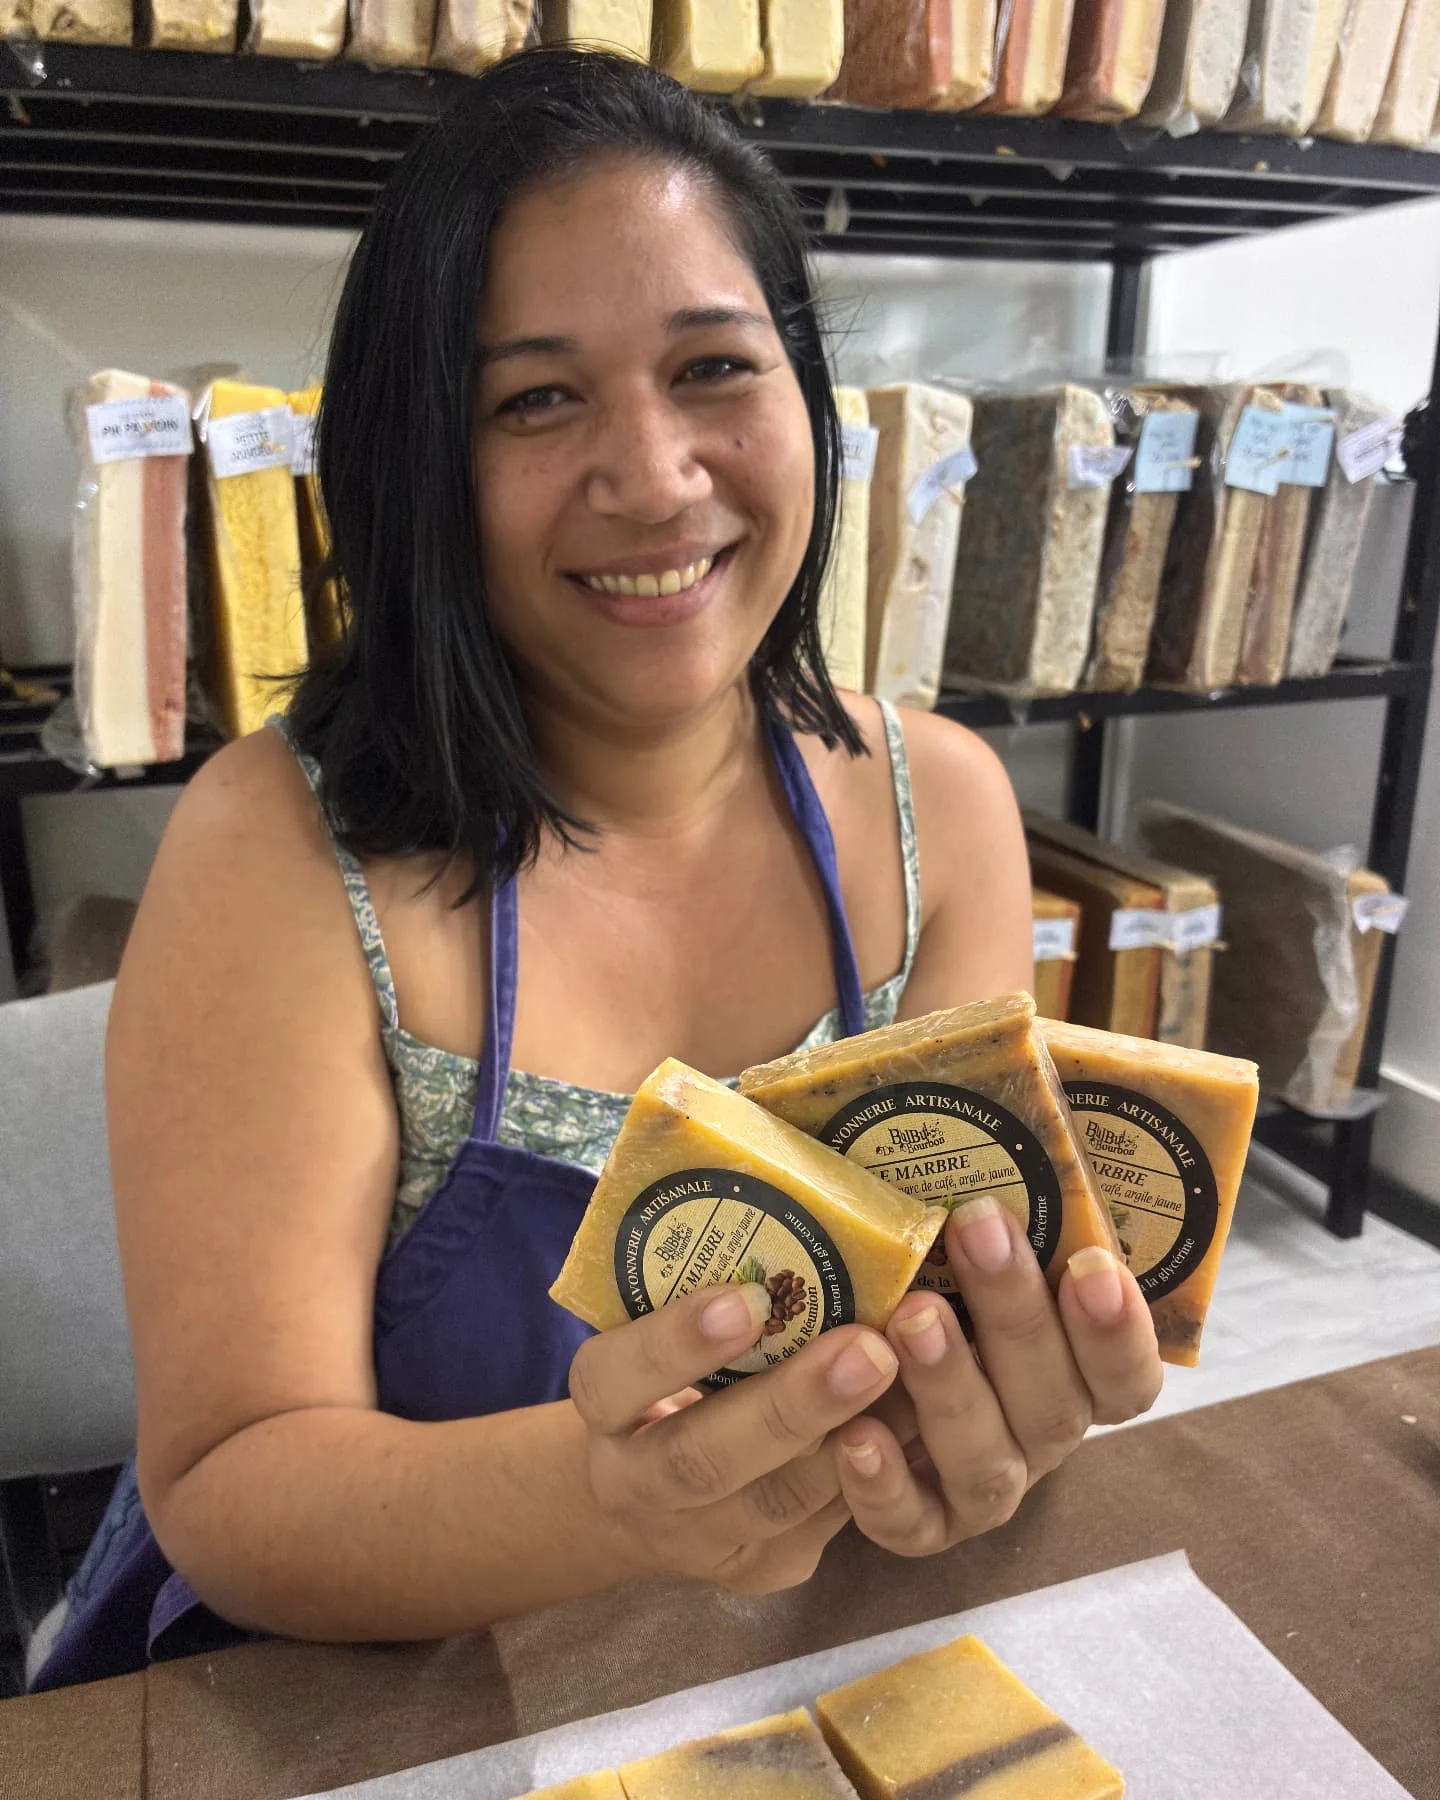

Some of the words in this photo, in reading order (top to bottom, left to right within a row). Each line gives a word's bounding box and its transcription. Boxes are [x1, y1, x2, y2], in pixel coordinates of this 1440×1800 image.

[832, 1098, 897, 1150] VONNERIE
[905, 1094, 1003, 1132] ARTISANALE
[1068, 1093, 1110, 1107] NERIE
[1117, 1101, 1196, 1169] ARTISANALE
[907, 1136, 945, 1154] Bourbon
[1095, 1141, 1135, 1156] Bourbon
[895, 1154, 971, 1181] MARBRE
[921, 1180, 934, 1192] de
[935, 1176, 957, 1193] café,
[959, 1172, 986, 1187] argile
[988, 1166, 1016, 1181] jaune
[1092, 1160, 1148, 1187] ARBRE
[1100, 1182, 1122, 1197] café,
[1124, 1188, 1153, 1204] argile
[1152, 1194, 1181, 1212] jaune
[784, 1210, 829, 1258] glycérine
[1031, 1195, 1048, 1249] glycérine
[626, 1227, 649, 1313] SAVONNERIE
[640, 1180, 713, 1226] ARTISANALE
[673, 1227, 694, 1260] Bourbon
[686, 1225, 725, 1288] MARBRE
[711, 1269, 721, 1280] de
[727, 1231, 744, 1253] argile
[740, 1207, 757, 1235] jaune
[822, 1261, 833, 1272] la
[828, 1273, 837, 1281] à
[1144, 1277, 1159, 1288] la
[1158, 1238, 1195, 1282] glycérine
[917, 1275, 935, 1287] de
[938, 1276, 952, 1288] la
[800, 1285, 819, 1336] Réunion
[830, 1283, 843, 1318] Savon
[782, 1345, 798, 1360] de
[796, 1334, 808, 1350] la
[764, 1351, 781, 1367] Île
